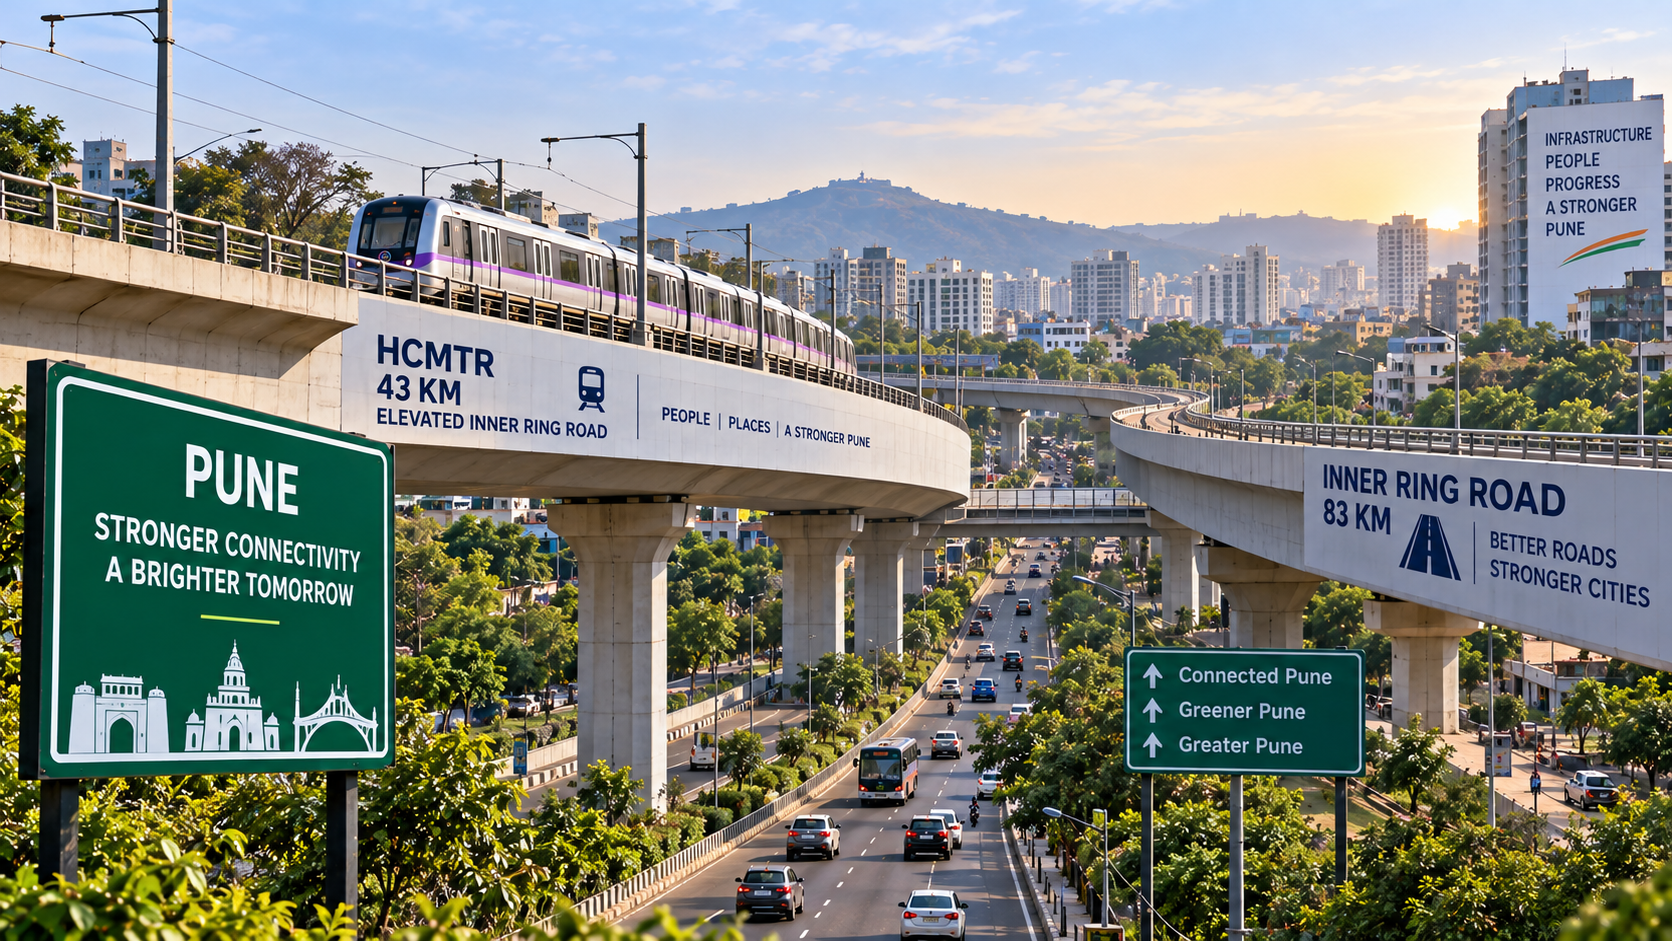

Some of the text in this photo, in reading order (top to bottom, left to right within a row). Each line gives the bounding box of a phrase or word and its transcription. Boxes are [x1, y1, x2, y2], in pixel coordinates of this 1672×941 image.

[1546, 126, 1652, 146] INFRASTRUCTURE
[1546, 152, 1600, 169] PEOPLE
[1546, 174, 1620, 192] PROGRESS
[1546, 197, 1637, 215] A STRONGER
[1546, 221, 1585, 237] PUNE
[378, 334, 494, 378] HCMTR
[377, 374, 461, 406] 43 KM
[377, 407, 607, 439] ELEVATED INNER RING ROAD
[662, 407, 870, 448] PEOPLE PLACES A STRONGER PUNE
[186, 443, 298, 515] PUNE
[1324, 464, 1565, 517] INNER RING ROAD
[1323, 498, 1391, 535] 83 KM
[94, 512, 361, 573] STRONGER CONNECTIVITY
[1490, 531, 1617, 569] BETTER ROADS
[105, 556, 354, 606] A BRIGHTER TOMORROW
[1490, 559, 1650, 608] STRONGER CITIES
[1179, 666, 1332, 685] Connected Pune
[1179, 701, 1306, 720] Greener Pune
[1179, 736, 1303, 754] Greater Pune
